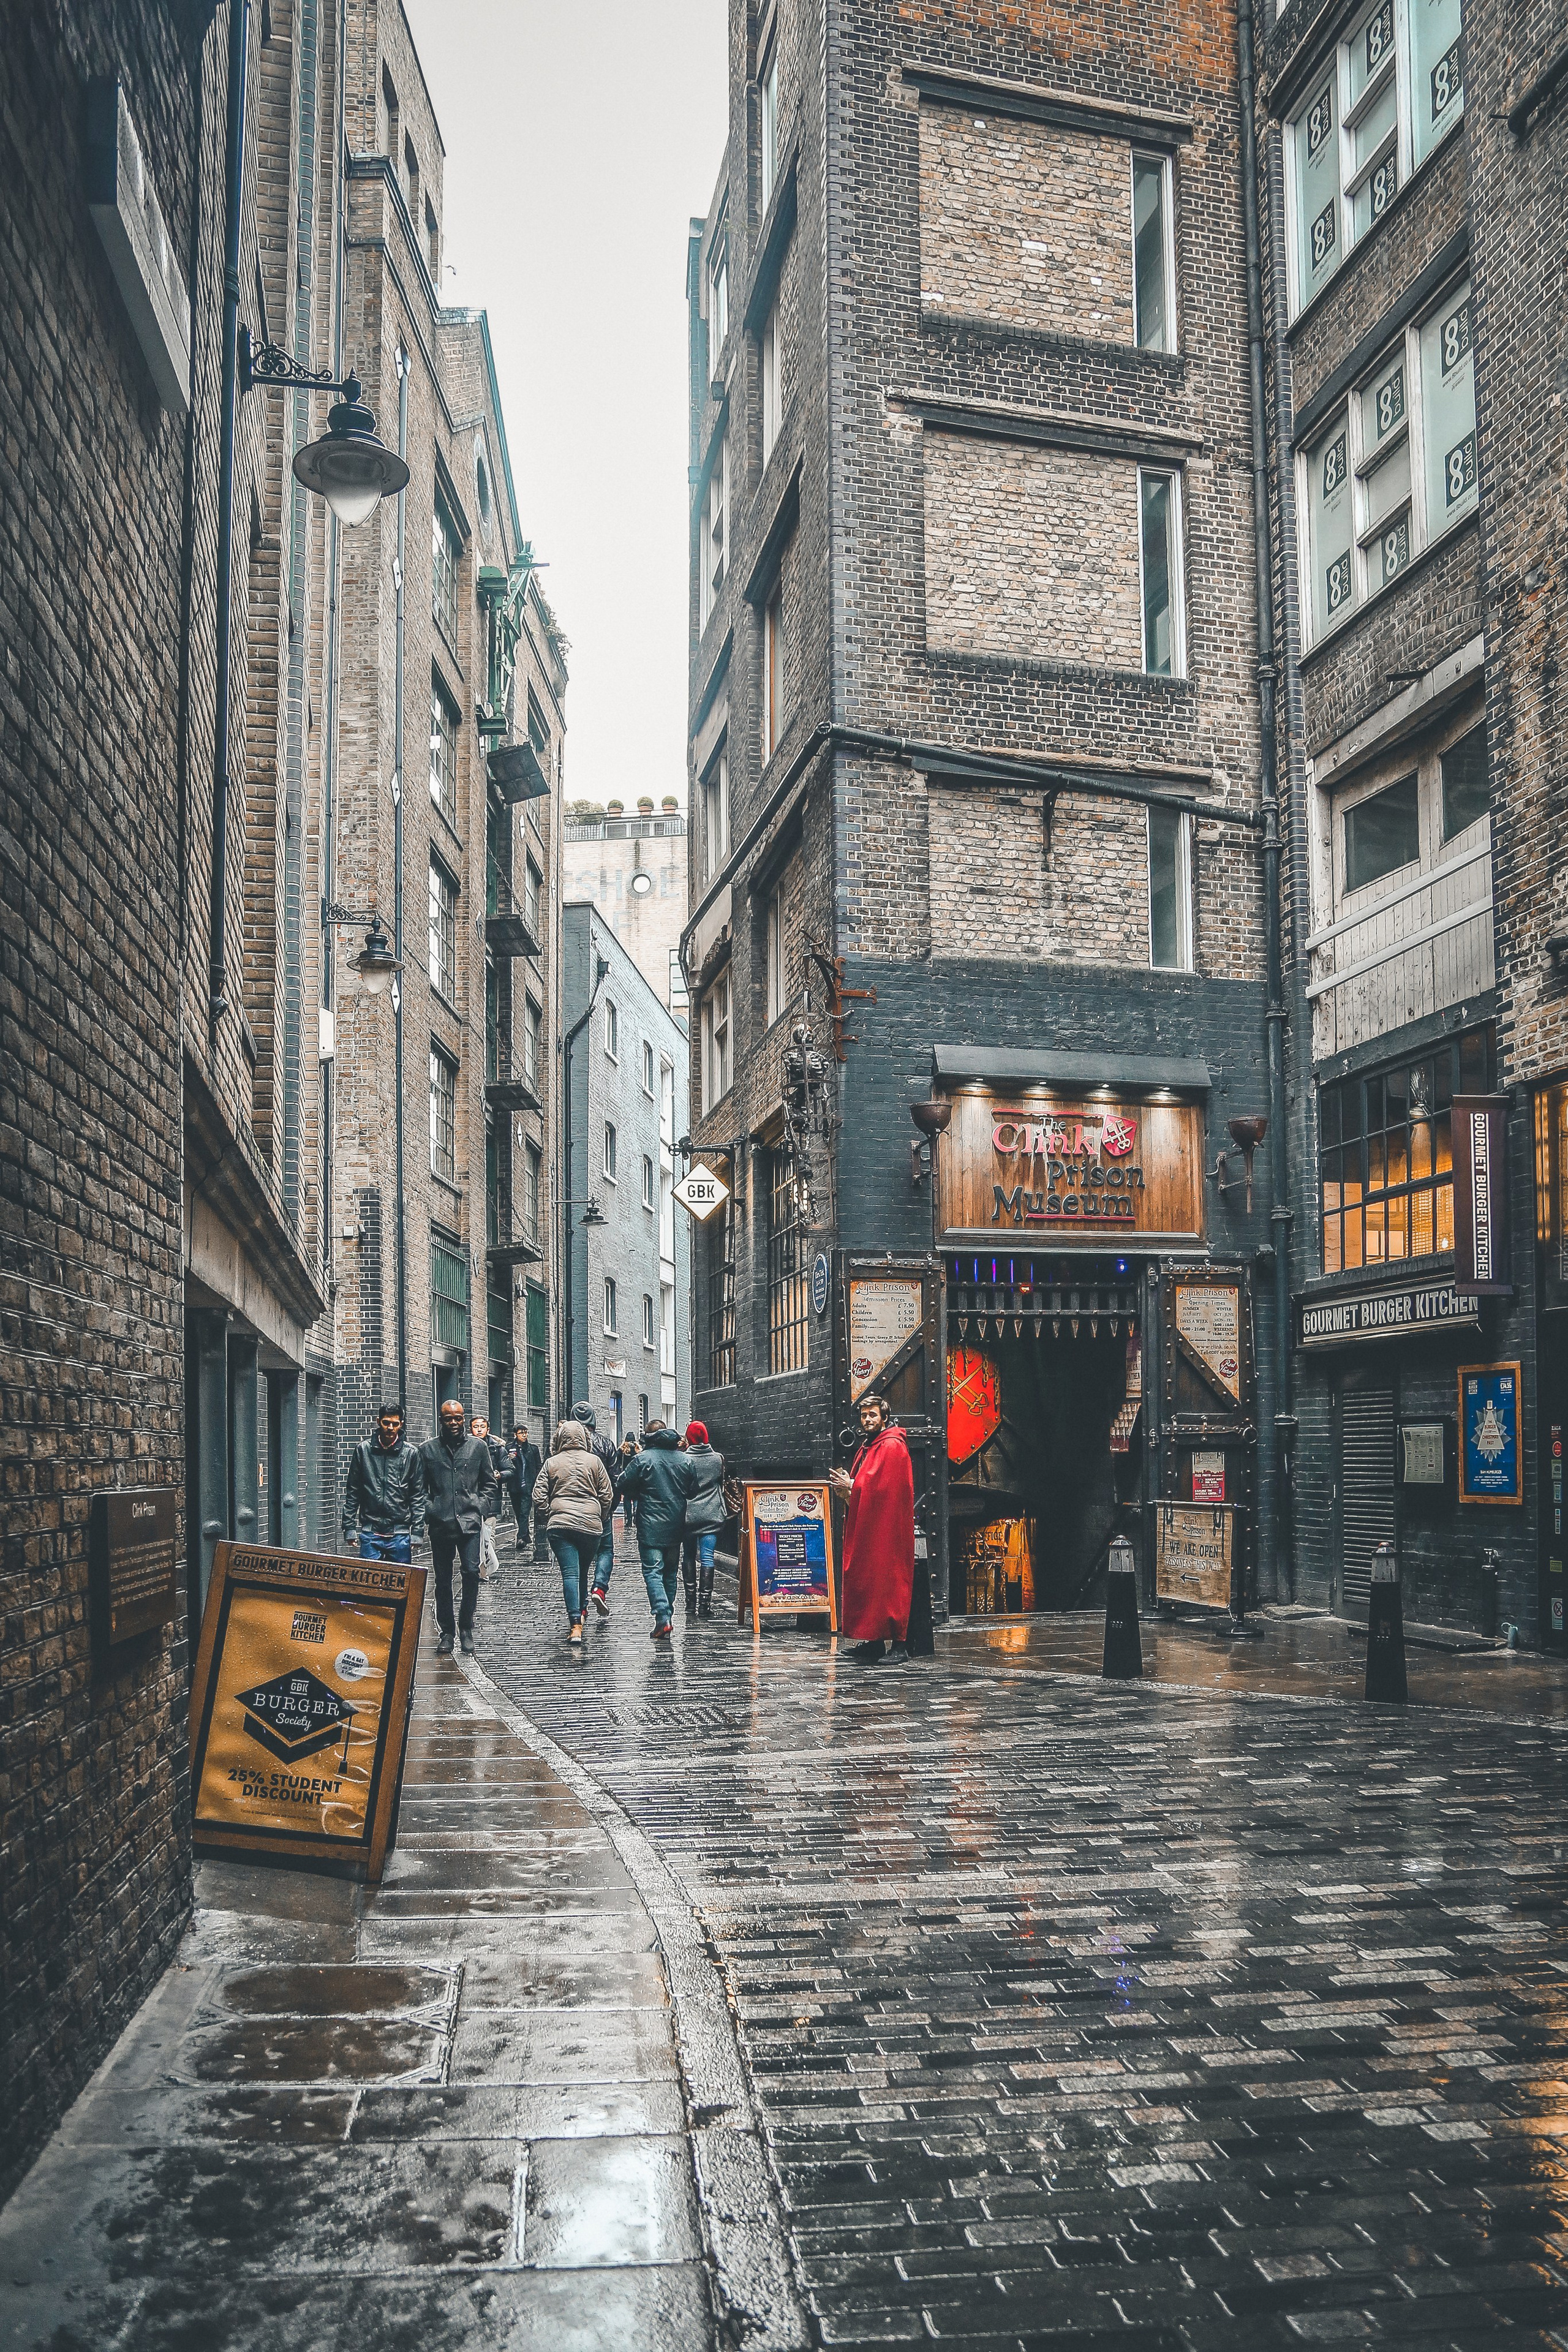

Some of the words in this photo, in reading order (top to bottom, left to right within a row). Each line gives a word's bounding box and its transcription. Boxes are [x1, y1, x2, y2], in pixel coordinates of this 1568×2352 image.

[1039, 1116, 1066, 1130] The
[992, 1122, 1101, 1156] Clink
[1474, 1113, 1487, 1172] GOURMET
[1046, 1160, 1146, 1190] Prison
[688, 1185, 715, 1198] GBK
[1476, 1175, 1487, 1223] BURGER
[991, 1185, 1133, 1221] Museum
[1477, 1224, 1488, 1280] KITCHEN
[858, 1283, 880, 1291] Clink
[1303, 1305, 1358, 1333] GOURMET
[1362, 1295, 1411, 1326] BURGER
[854, 1359, 867, 1369] Real
[132, 1502, 143, 1518] Clink
[143, 1502, 156, 1516] Prison
[1185, 1515, 1198, 1525] Clink
[1170, 1541, 1180, 1554] WE
[1183, 1544, 1196, 1556] ARE
[1199, 1545, 1218, 1558] OPEN
[233, 1554, 295, 1575] GOURMET
[297, 1563, 347, 1582] BURGER
[350, 1569, 405, 1589] KITCHEN
[1165, 1556, 1193, 1569] PRISONERS
[1194, 1559, 1206, 1570] THIS
[1208, 1561, 1221, 1571] WAY
[294, 1613, 328, 1624] GOURMET
[290, 1629, 325, 1641] KITCHEN
[292, 1621, 326, 1634] BURGER
[341, 1659, 363, 1668] DISCOUNT
[291, 1682, 309, 1693] GBK
[252, 1693, 340, 1716] BURGER
[276, 1713, 312, 1731] Society
[227, 1768, 265, 1785] 25%
[270, 1773, 342, 1793] STUDENT
[241, 1783, 324, 1805] DISCOUNT
